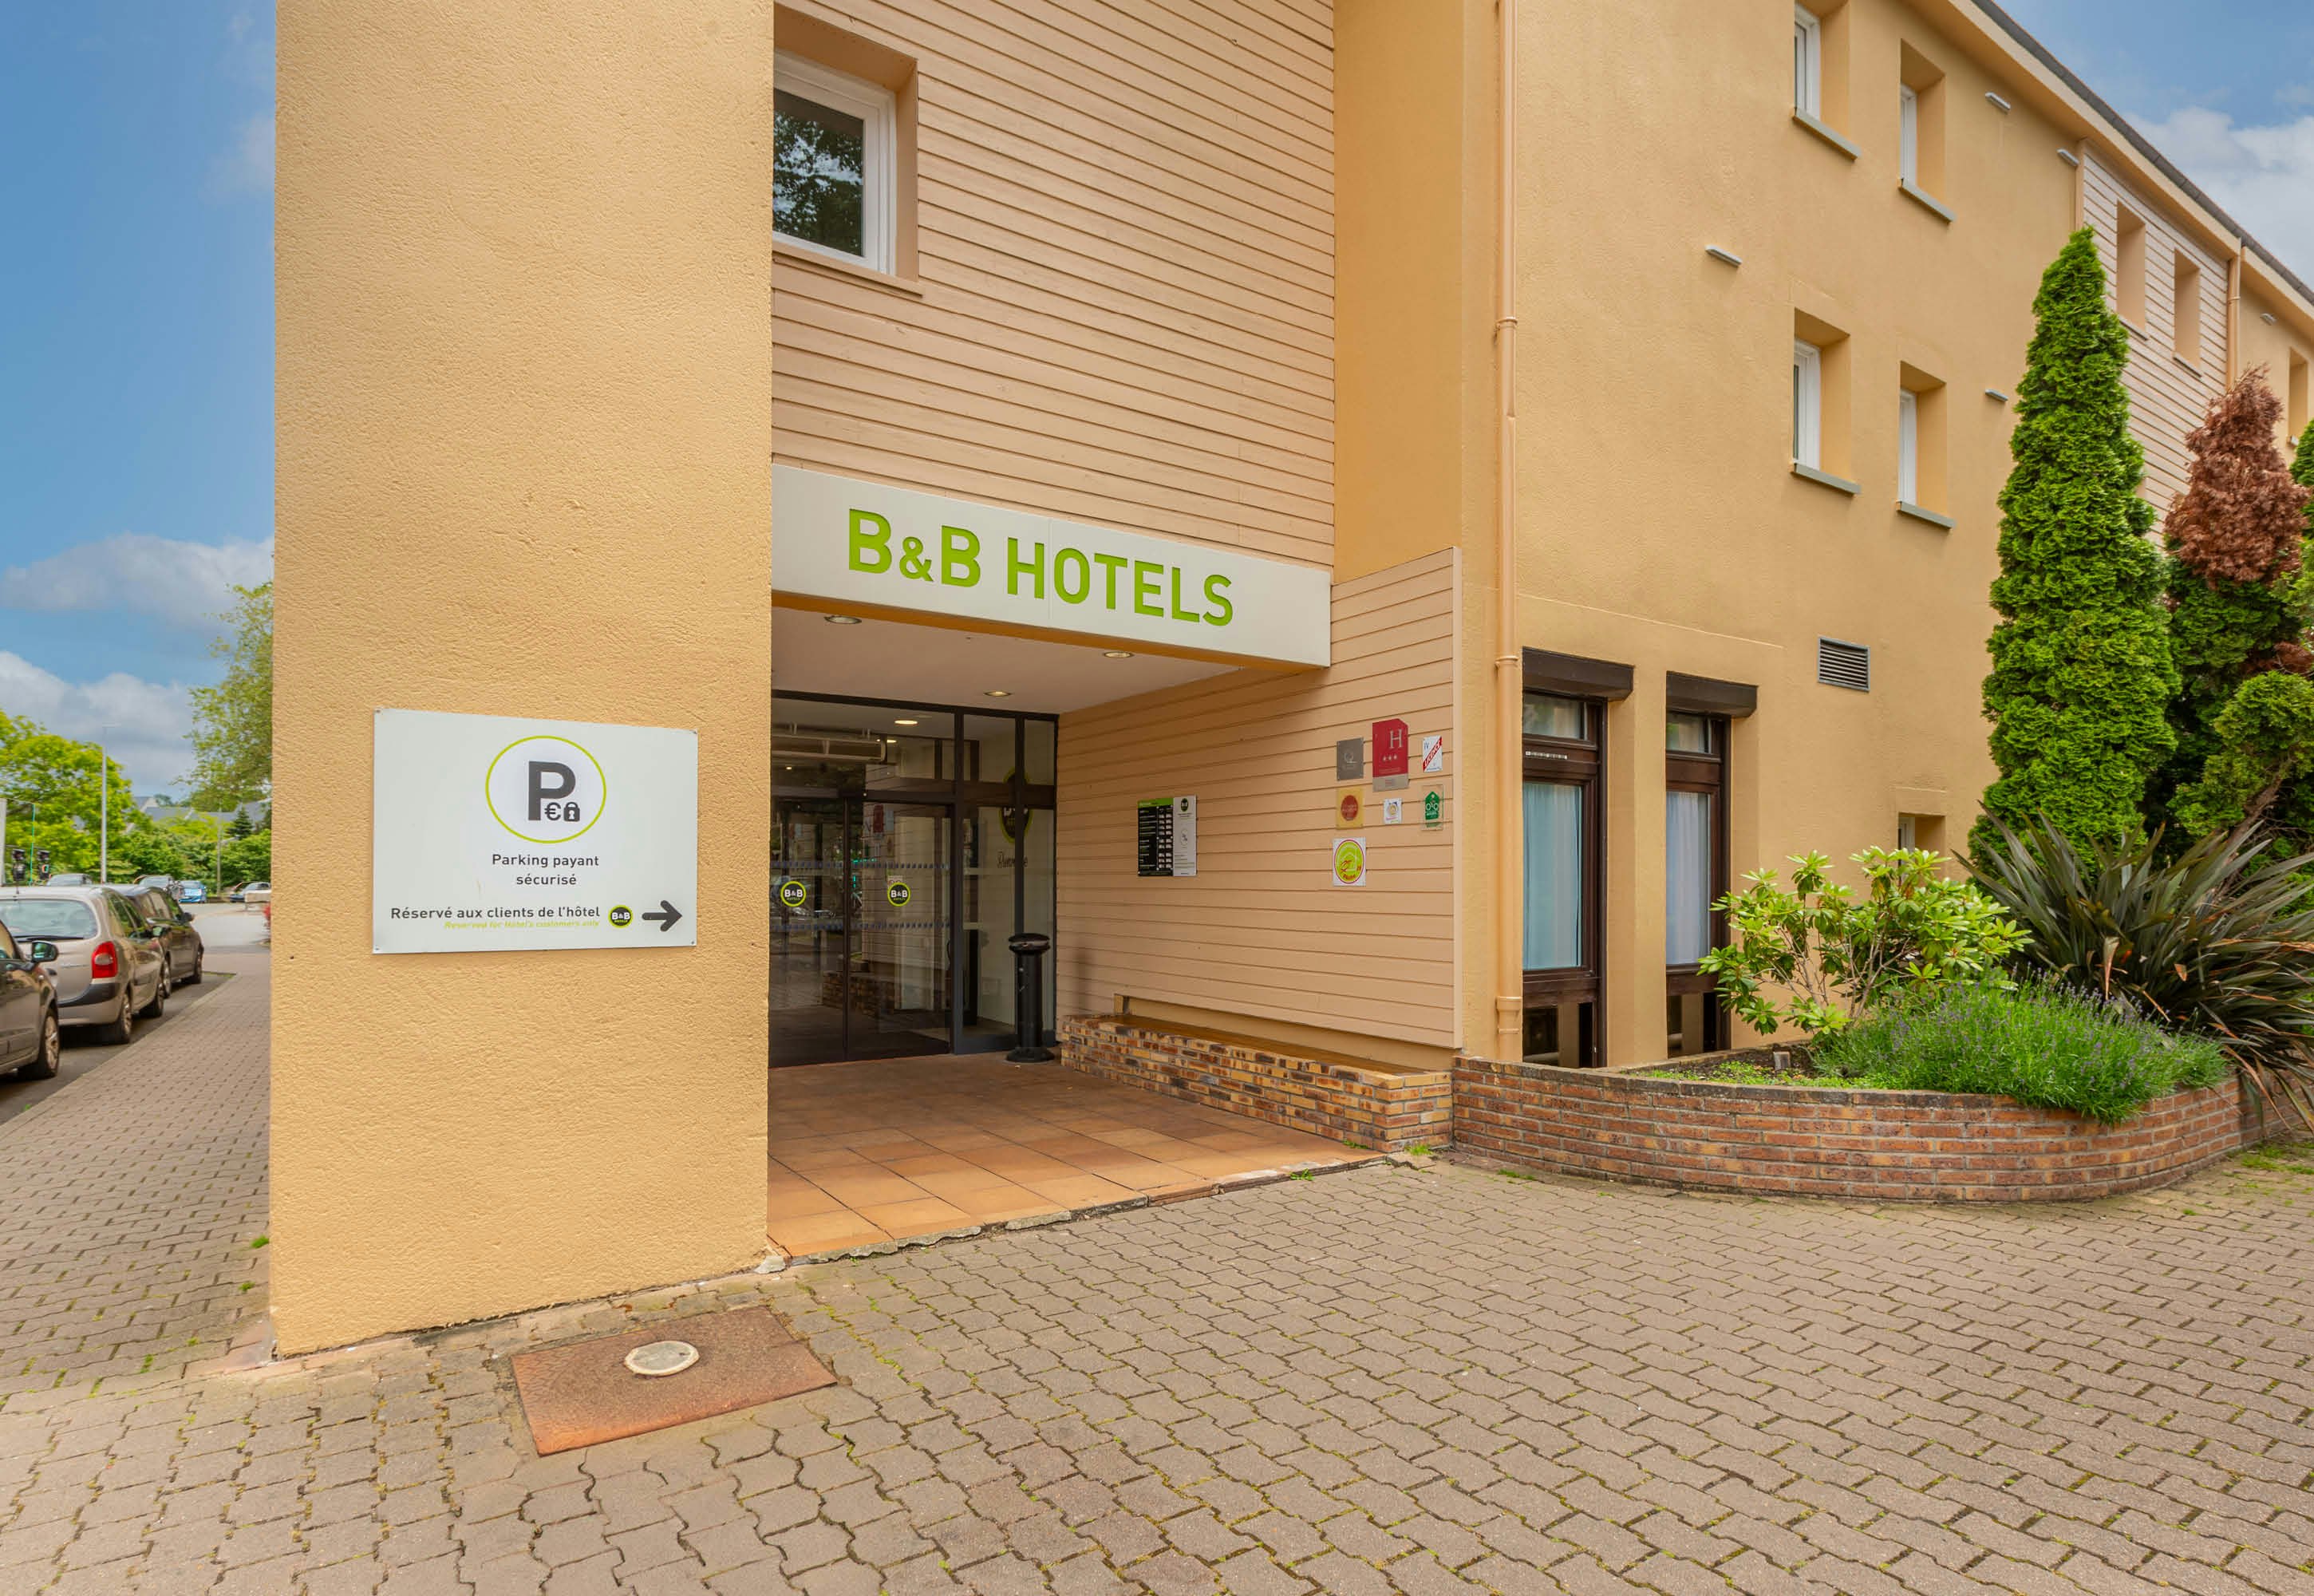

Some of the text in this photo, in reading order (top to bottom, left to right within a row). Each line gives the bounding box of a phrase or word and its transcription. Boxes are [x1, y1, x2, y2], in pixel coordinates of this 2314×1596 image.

[848, 508, 1234, 627] B&B HOTELS
[1390, 728, 1404, 749] H
[527, 760, 576, 821] P
[492, 853, 600, 868] Parking payant
[516, 873, 577, 886] sécurisé
[784, 889, 804, 898] B&B
[390, 906, 600, 919] Réservé aux clients de l'hôtel
